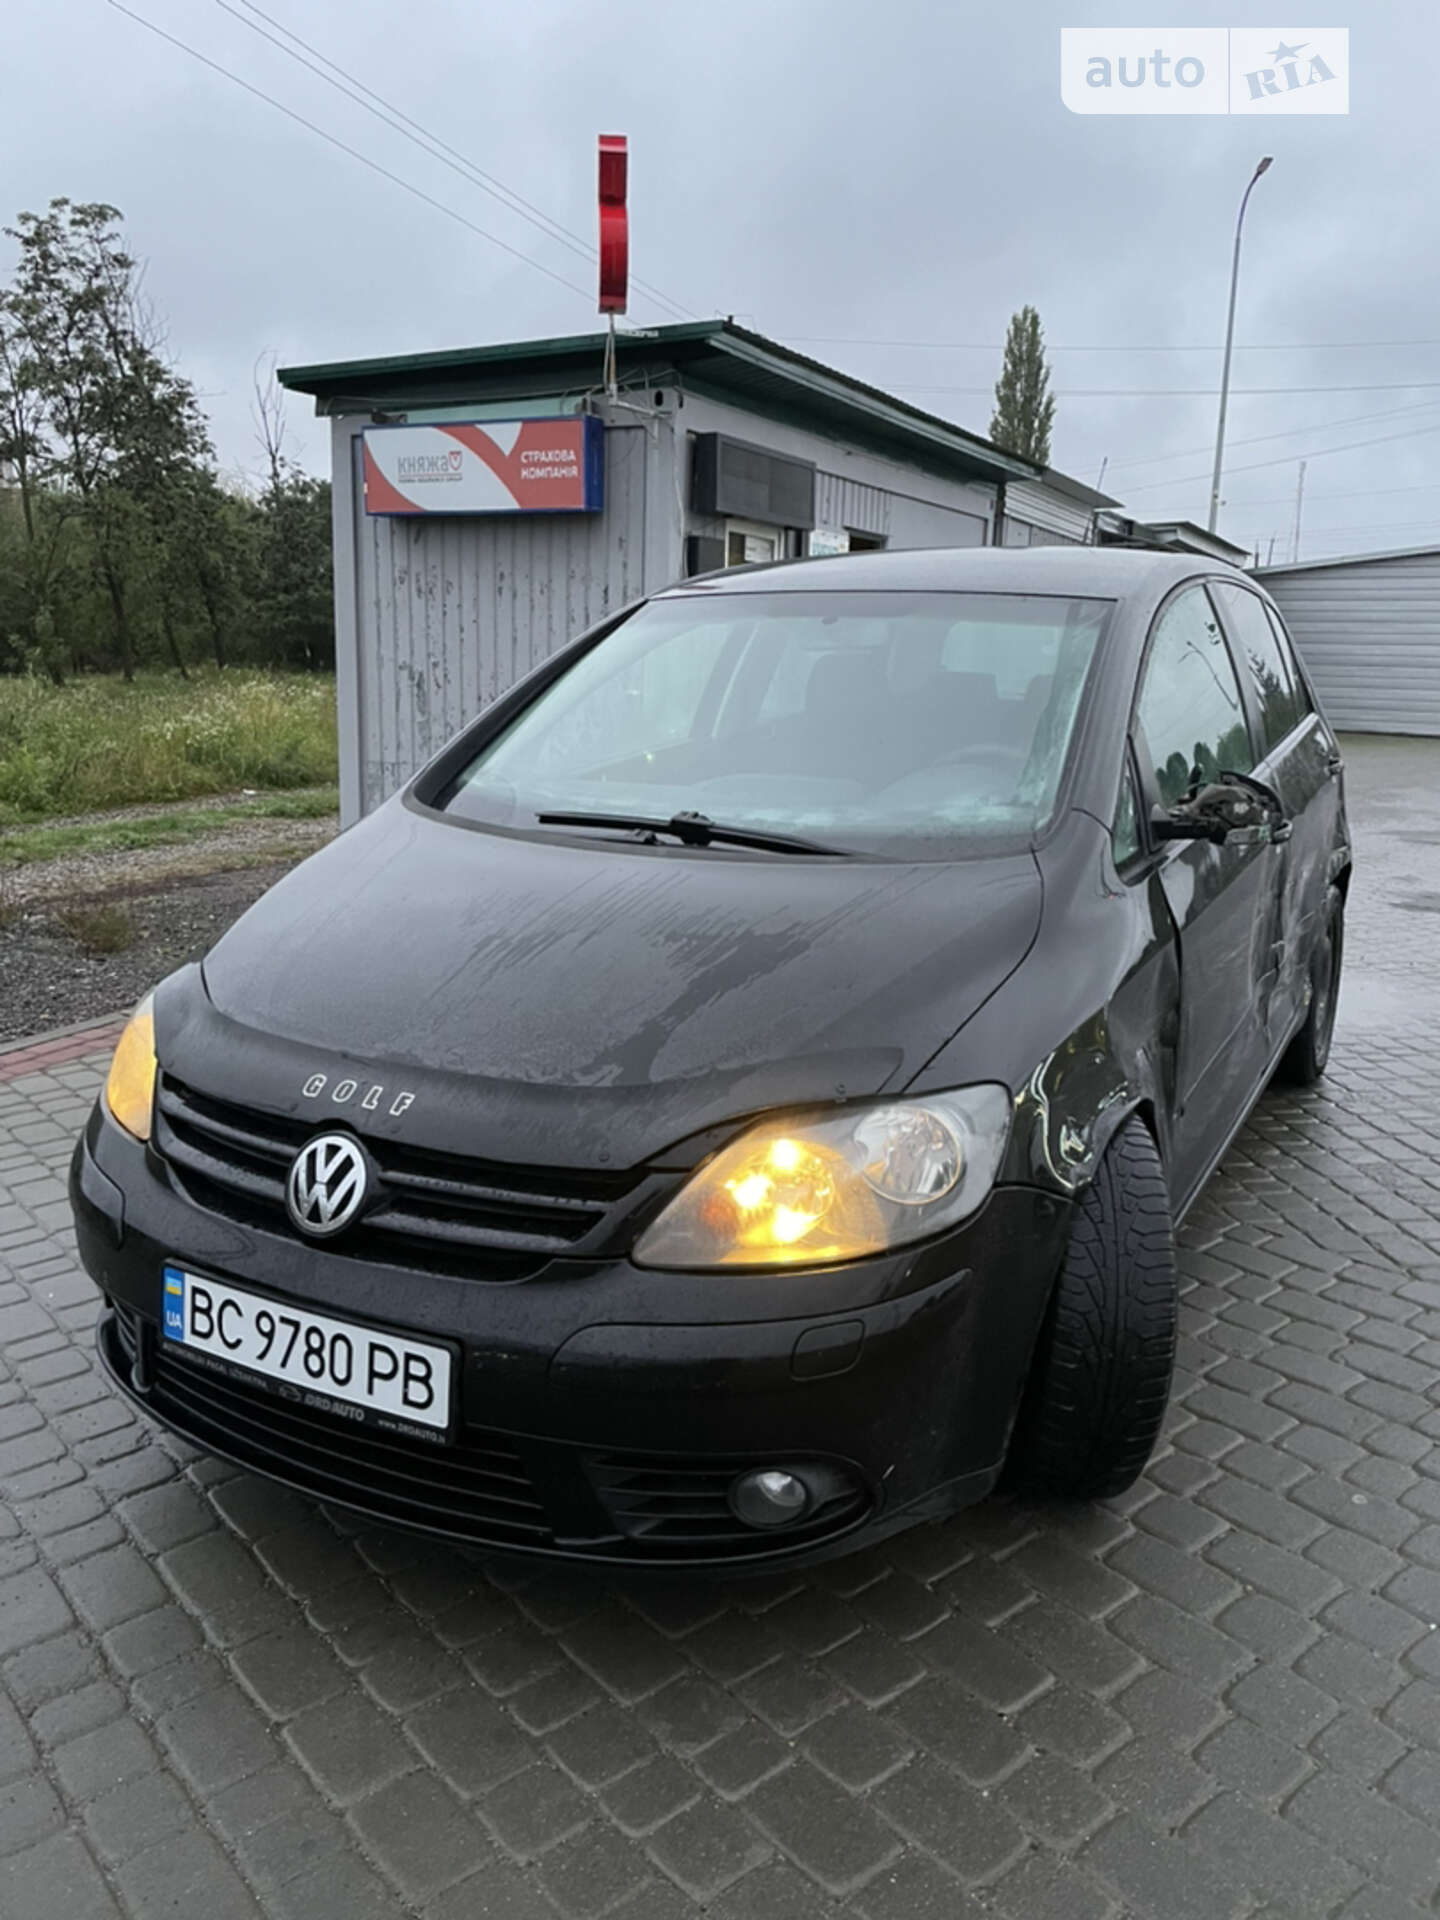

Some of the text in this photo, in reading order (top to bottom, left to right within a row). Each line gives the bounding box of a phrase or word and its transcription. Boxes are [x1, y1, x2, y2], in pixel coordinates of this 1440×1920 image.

[520, 449, 576, 464] СТРАХОВА
[520, 465, 578, 481] КОМПАНІЯ
[302, 1073, 416, 1116] GOLF
[166, 1310, 183, 1329] UA
[190, 1285, 244, 1350] BC
[255, 1310, 353, 1387] 9780
[366, 1341, 435, 1410] PB
